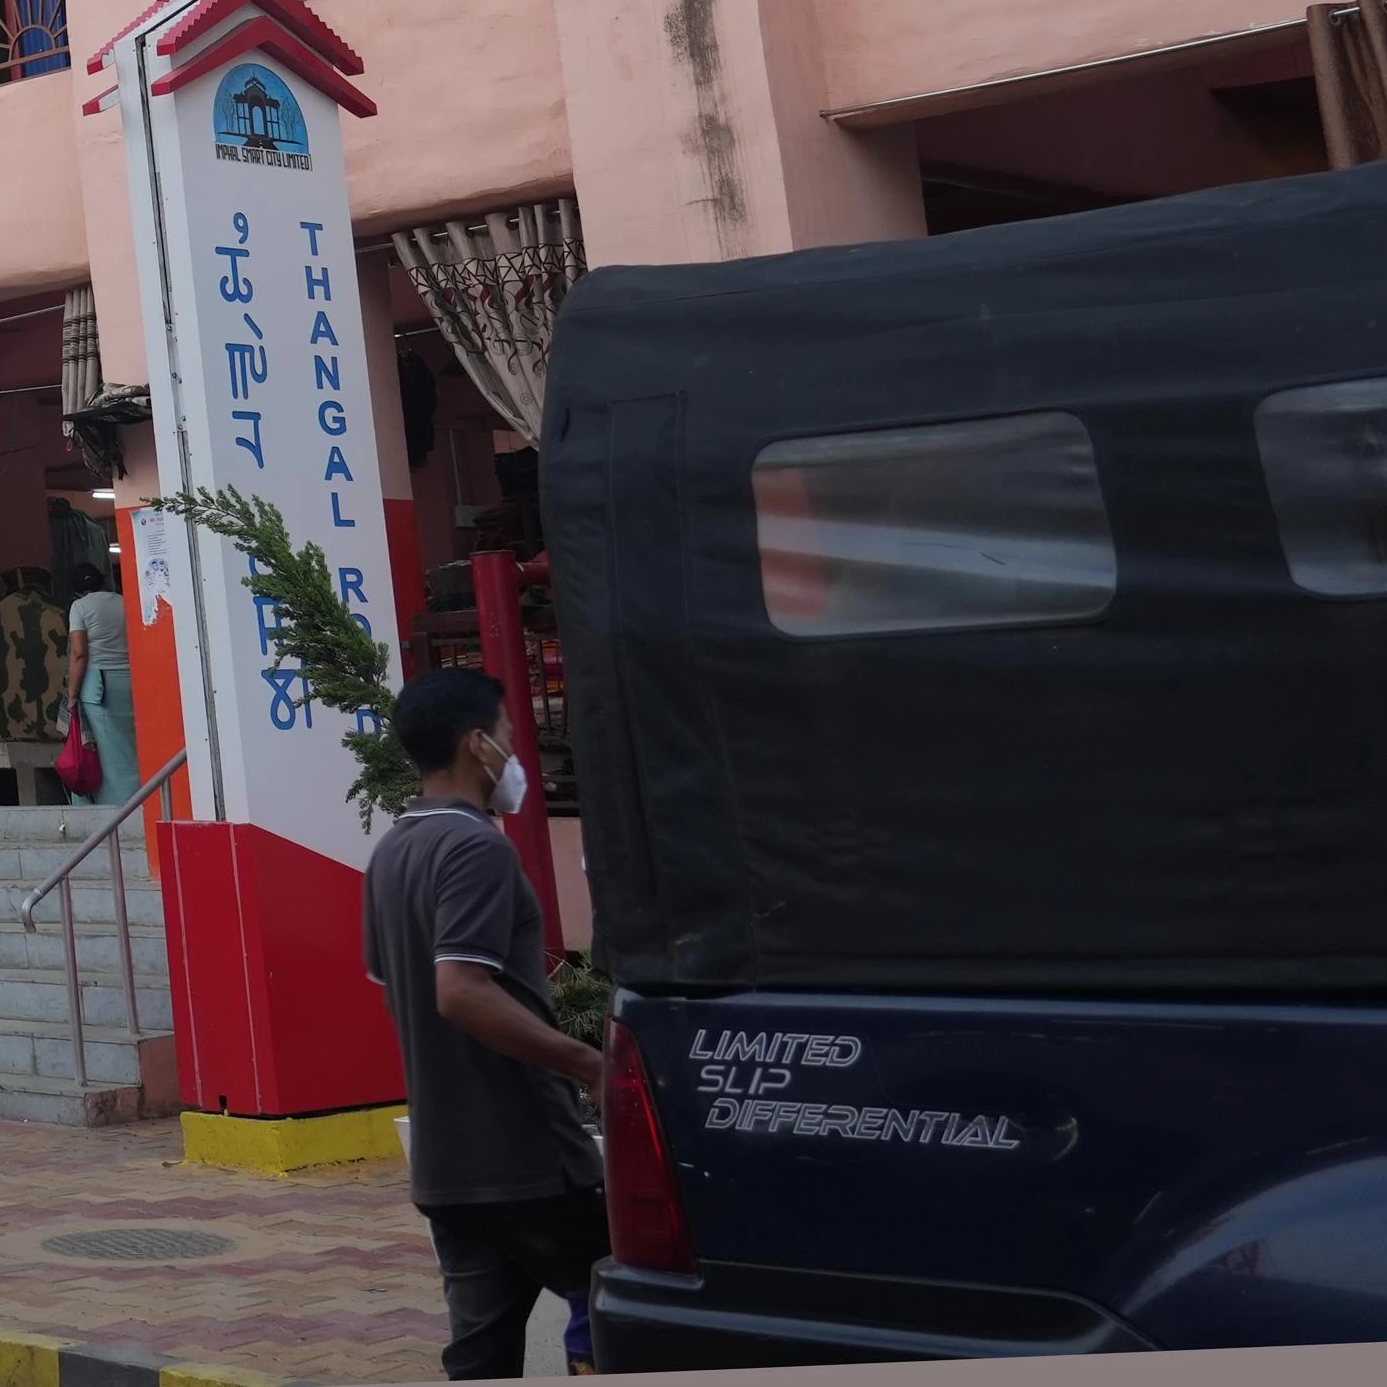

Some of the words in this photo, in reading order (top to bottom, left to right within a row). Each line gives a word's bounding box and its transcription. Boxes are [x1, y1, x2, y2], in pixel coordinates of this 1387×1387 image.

[215, 143, 241, 162] IMPHAL
[242, 147, 265, 166] SMART
[265, 150, 282, 167] CITY
[282, 152, 310, 171] LIMITED
[299, 221, 356, 528] THANGAL
[688, 1028, 863, 1068] LIMITED
[697, 1064, 792, 1096] SLIP
[704, 1097, 1021, 1150] DIFFERENTIAL
